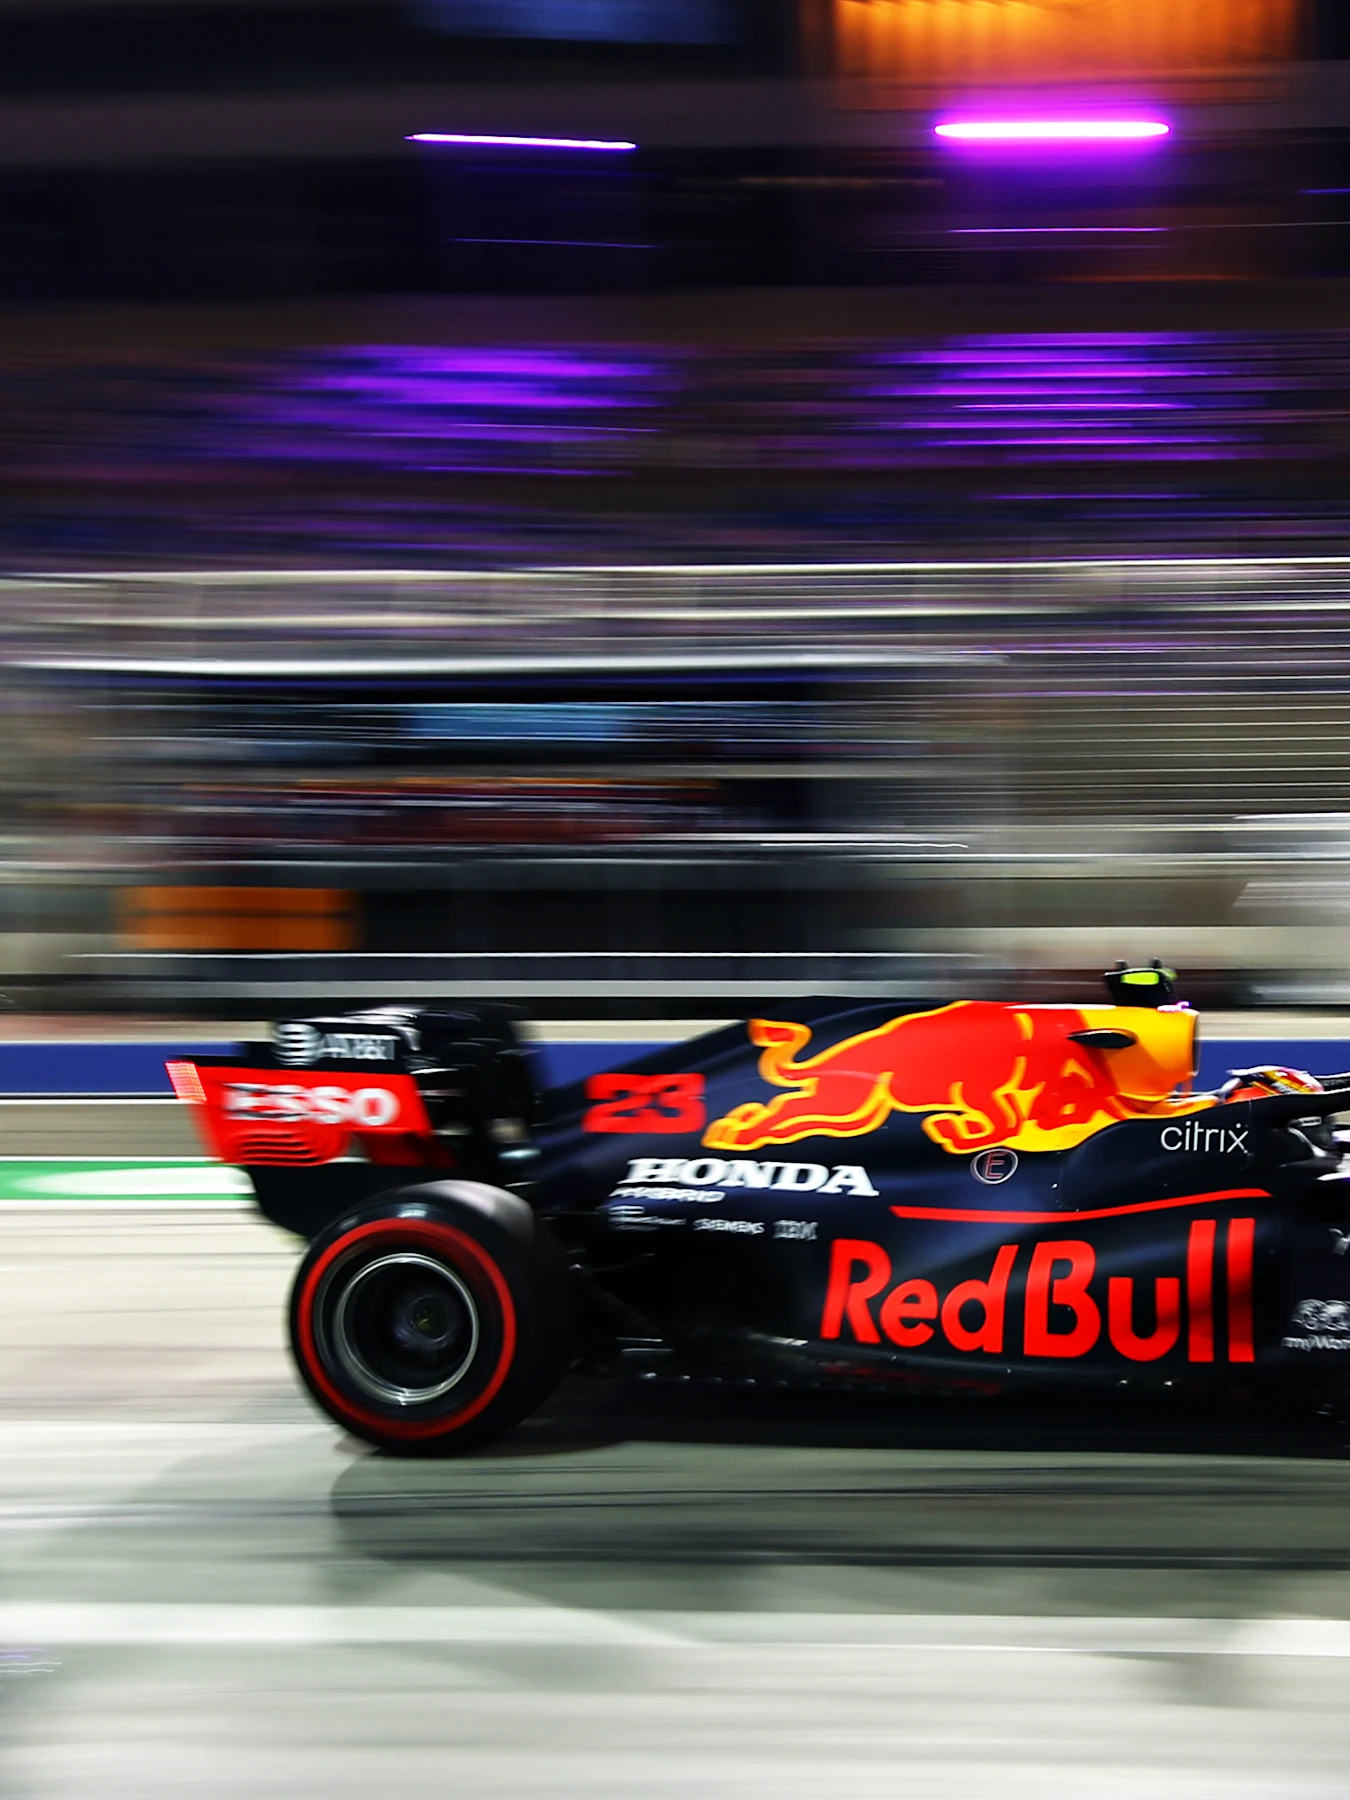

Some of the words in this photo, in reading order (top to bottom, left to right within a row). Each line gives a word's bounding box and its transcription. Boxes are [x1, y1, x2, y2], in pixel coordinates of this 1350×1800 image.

[582, 1073, 707, 1134] 23
[1160, 1120, 1250, 1154] citrix
[618, 1158, 880, 1197] HONDA
